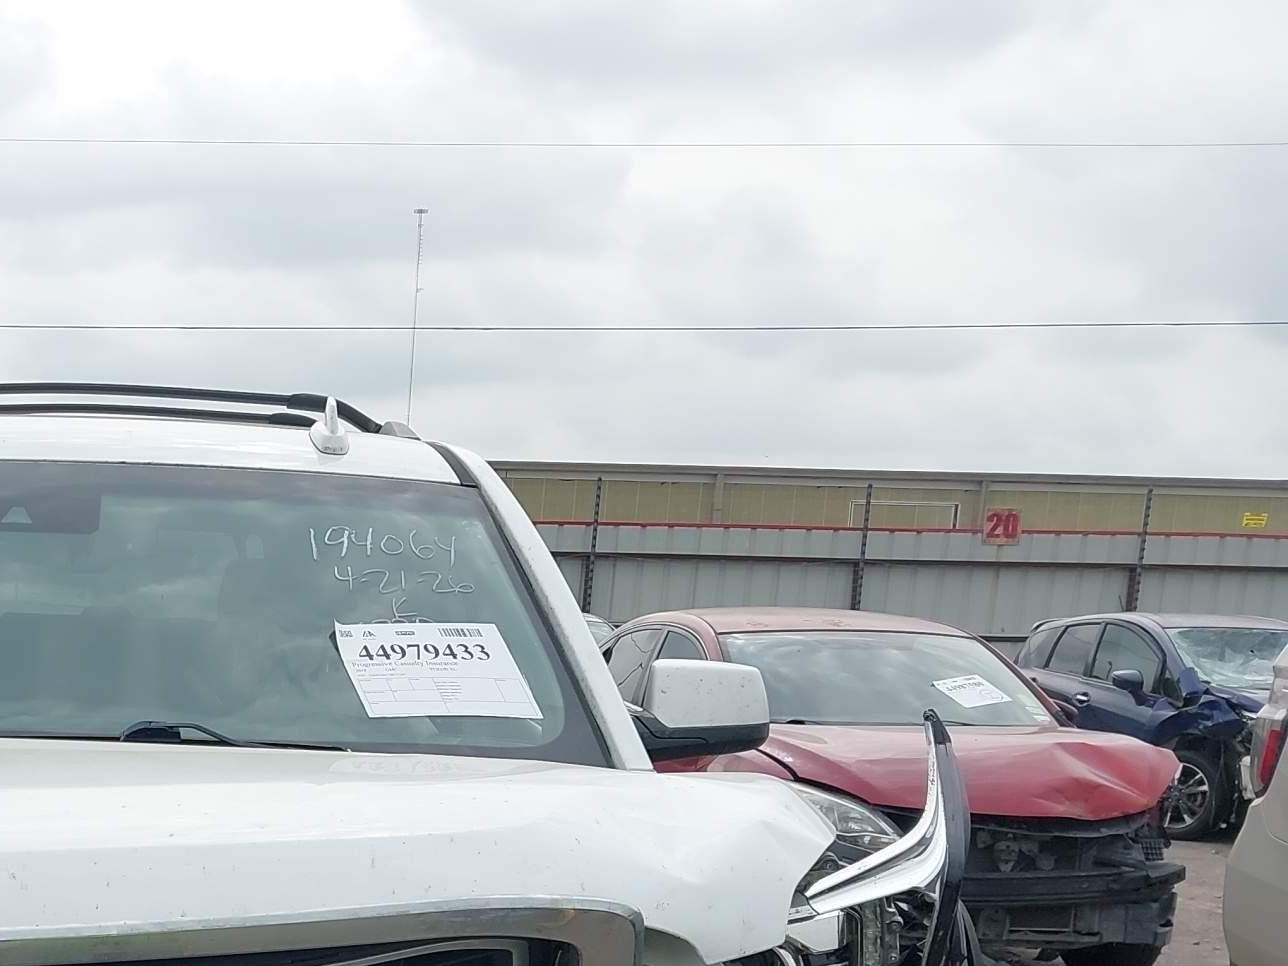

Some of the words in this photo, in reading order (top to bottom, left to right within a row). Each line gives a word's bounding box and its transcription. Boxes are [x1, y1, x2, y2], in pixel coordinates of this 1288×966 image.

[986, 511, 1019, 539] 20
[309, 526, 456, 567] 194064
[358, 643, 491, 661] 44979433
